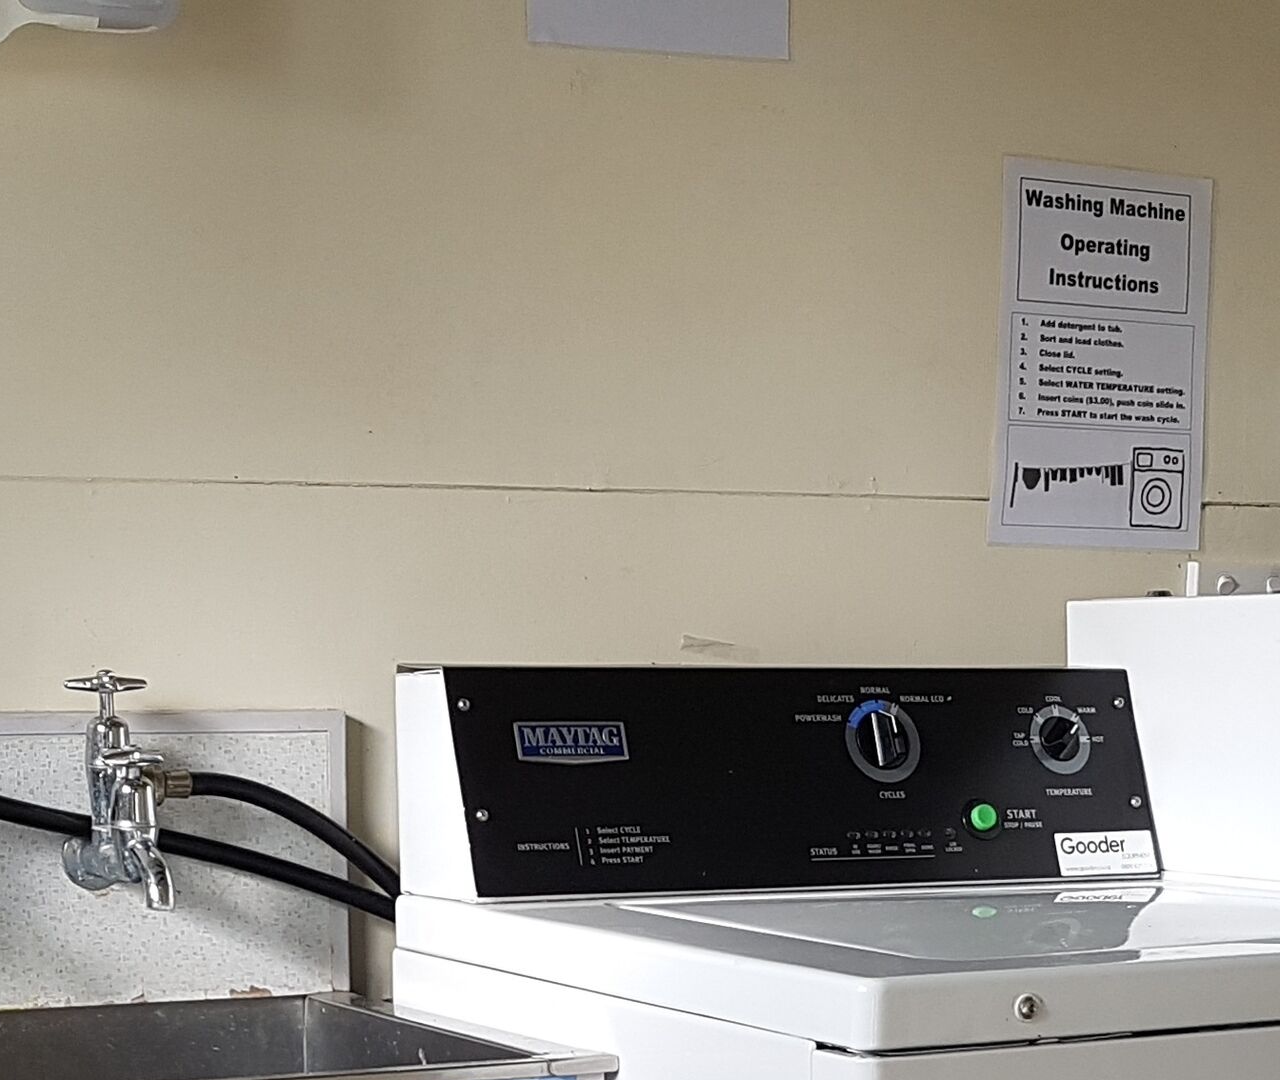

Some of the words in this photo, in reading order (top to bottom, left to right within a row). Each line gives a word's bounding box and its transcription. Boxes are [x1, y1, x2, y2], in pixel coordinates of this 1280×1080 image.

[1025, 188, 1104, 218] Washing
[1110, 197, 1186, 221] Machine
[1060, 233, 1150, 262] Operating
[1049, 268, 1159, 293] Instructions
[1021, 318, 1028, 326] 1.
[1040, 320, 1056, 328] Add
[1058, 320, 1096, 332] detergent
[1098, 324, 1106, 332] to
[1108, 324, 1122, 333] tub.
[1021, 333, 1028, 341] 2.
[1040, 334, 1056, 343] Sort
[1058, 336, 1072, 344] and
[1075, 336, 1092, 346] load
[1094, 338, 1124, 348] clothes.
[1039, 350, 1061, 358] Close
[1063, 350, 1075, 359] lid.
[1039, 364, 1064, 372] Select
[1066, 366, 1092, 374] CYCLE
[1094, 367, 1123, 378] setting.
[1038, 379, 1063, 388] Select
[1066, 380, 1094, 390] WATER
[1096, 382, 1154, 393] TEMPERATURE
[1156, 386, 1186, 397] setting.
[1038, 394, 1061, 403] Insert
[1062, 395, 1084, 404] coins
[1116, 399, 1134, 408] push
[1137, 400, 1154, 408] coin
[1156, 400, 1174, 410] slide
[1176, 402, 1186, 410] in.
[1018, 407, 1026, 415] 7.
[1037, 408, 1059, 418] Press
[1061, 409, 1088, 418] START
[1090, 411, 1098, 419] to
[1100, 412, 1118, 420] start
[1120, 413, 1132, 422] the
[1134, 414, 1154, 423] wash
[1157, 415, 1180, 424] cycle.
[860, 686, 890, 694] NORMAL
[817, 695, 854, 703] DELICATES
[794, 714, 842, 722] POWERWASH
[521, 726, 620, 746] MAYTAG
[540, 746, 605, 754] COMMERCIAL
[879, 790, 906, 799] CYCLES
[1046, 788, 1093, 796] TEMPERATURE
[1006, 809, 1036, 819] START
[620, 826, 640, 834] CYCLE
[517, 842, 570, 850] INSTRUCTIONS
[1060, 835, 1126, 854] Gooder
[622, 846, 654, 854] PAYMENT
[810, 847, 838, 856] STATUS
